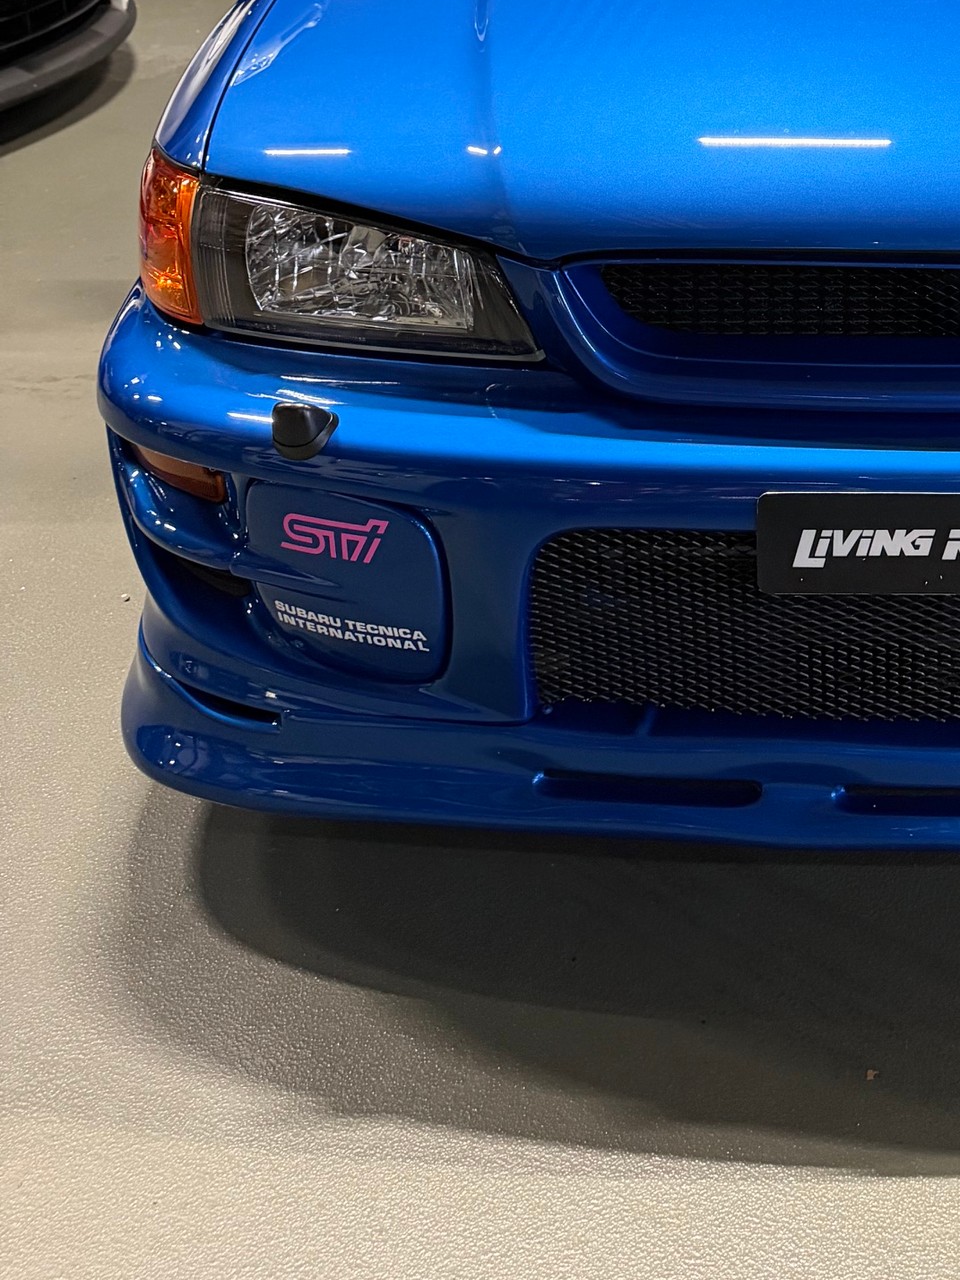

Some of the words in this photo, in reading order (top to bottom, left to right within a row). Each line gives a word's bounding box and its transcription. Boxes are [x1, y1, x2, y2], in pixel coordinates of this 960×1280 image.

[274, 599, 342, 627] SUBARU
[344, 620, 427, 641] TECNICA
[277, 612, 430, 652] INTERNATIONAL
